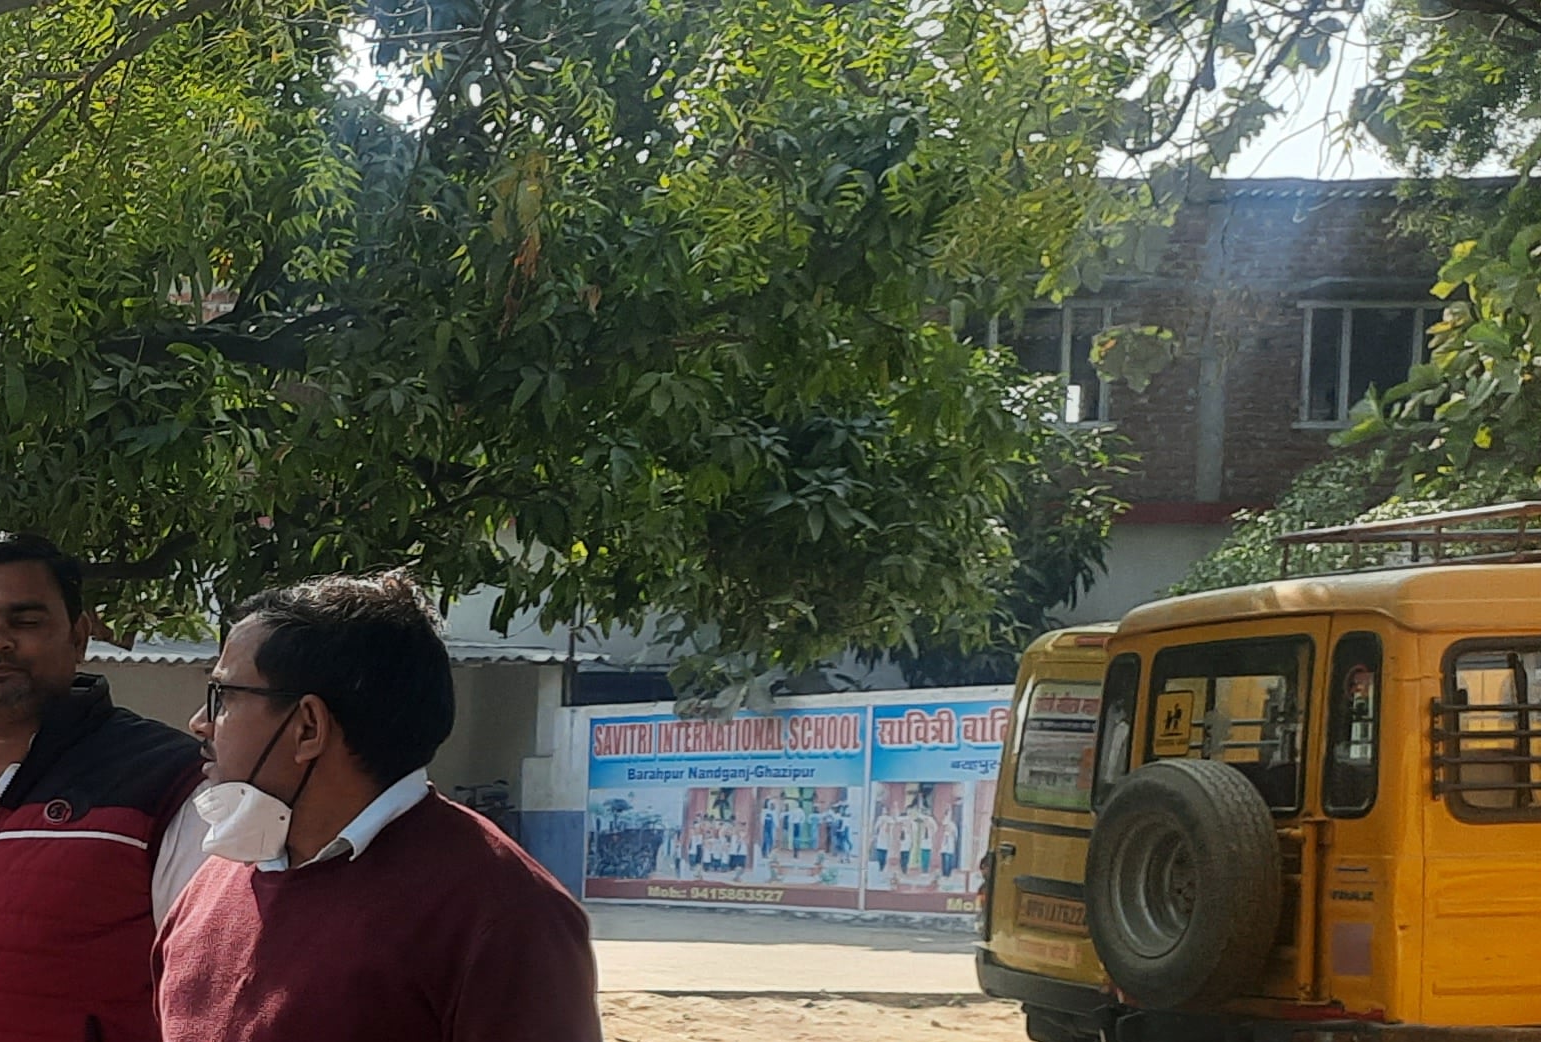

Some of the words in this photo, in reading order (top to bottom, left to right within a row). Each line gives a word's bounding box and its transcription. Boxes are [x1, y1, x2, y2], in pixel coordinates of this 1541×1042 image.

[594, 723, 653, 756] SAVITRI
[658, 718, 784, 754] INTERNATIONAL
[789, 714, 861, 750] SCHOOL
[878, 709, 955, 745] सावित्री
[627, 767, 684, 783] Barahpur
[688, 764, 816, 782] Nandganj-Ghazipur
